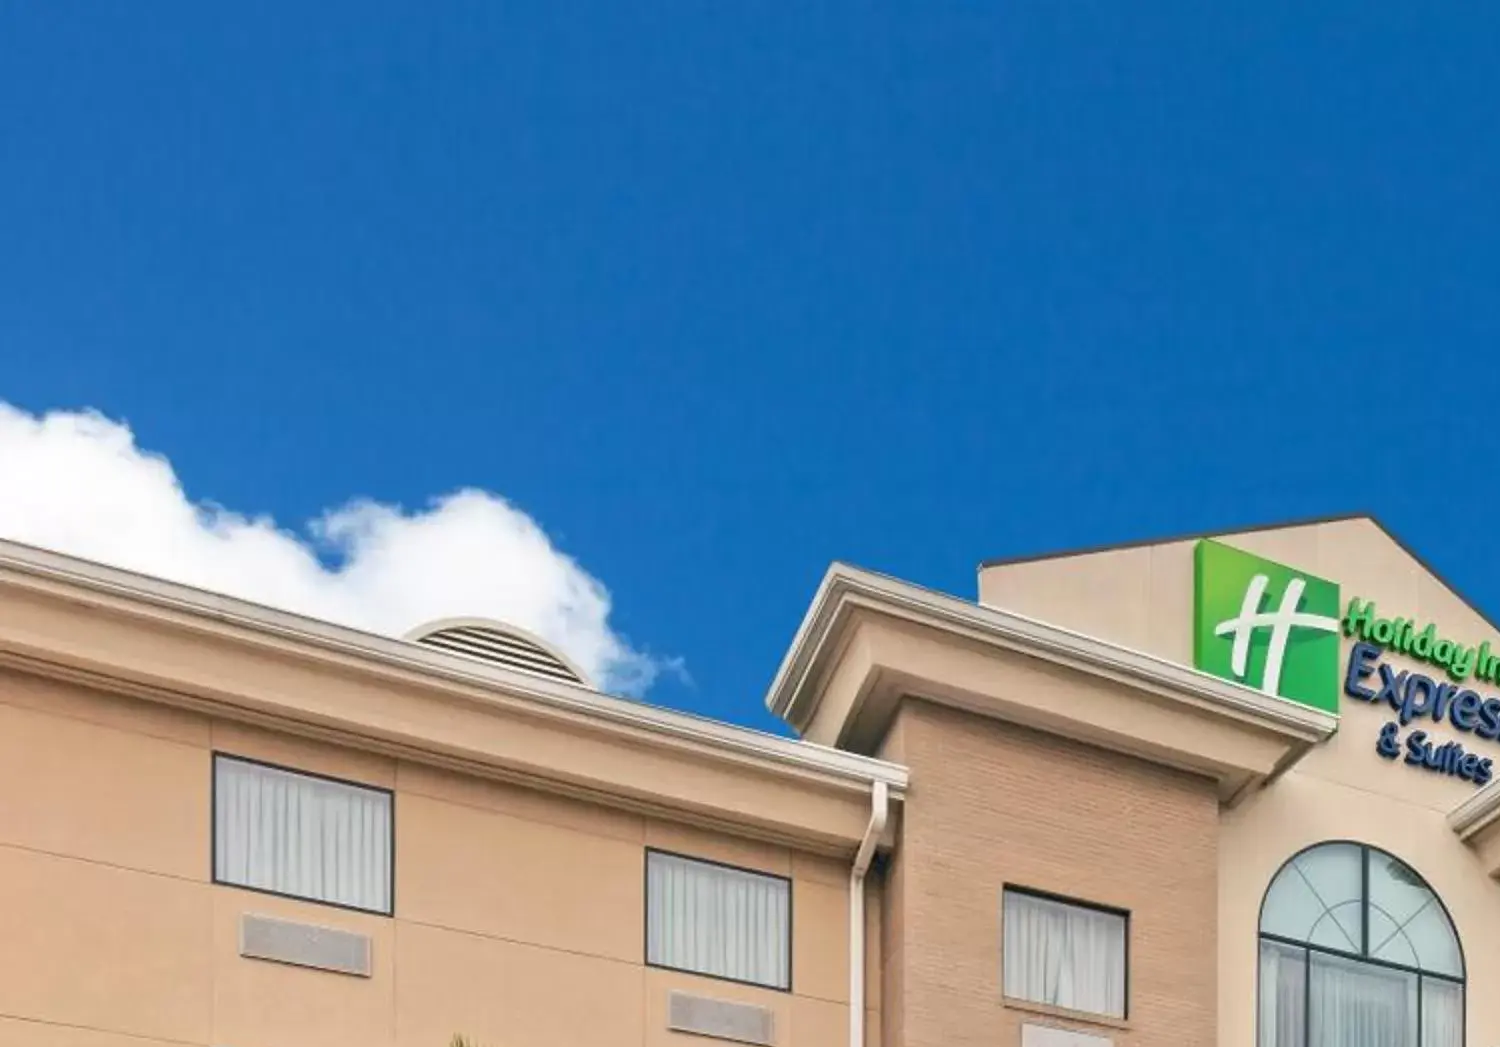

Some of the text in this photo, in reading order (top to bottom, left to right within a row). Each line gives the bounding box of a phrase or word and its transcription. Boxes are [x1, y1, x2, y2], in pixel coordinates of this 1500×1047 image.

[1342, 596, 1476, 681] Holiday
[1376, 721, 1493, 785] & Suites
